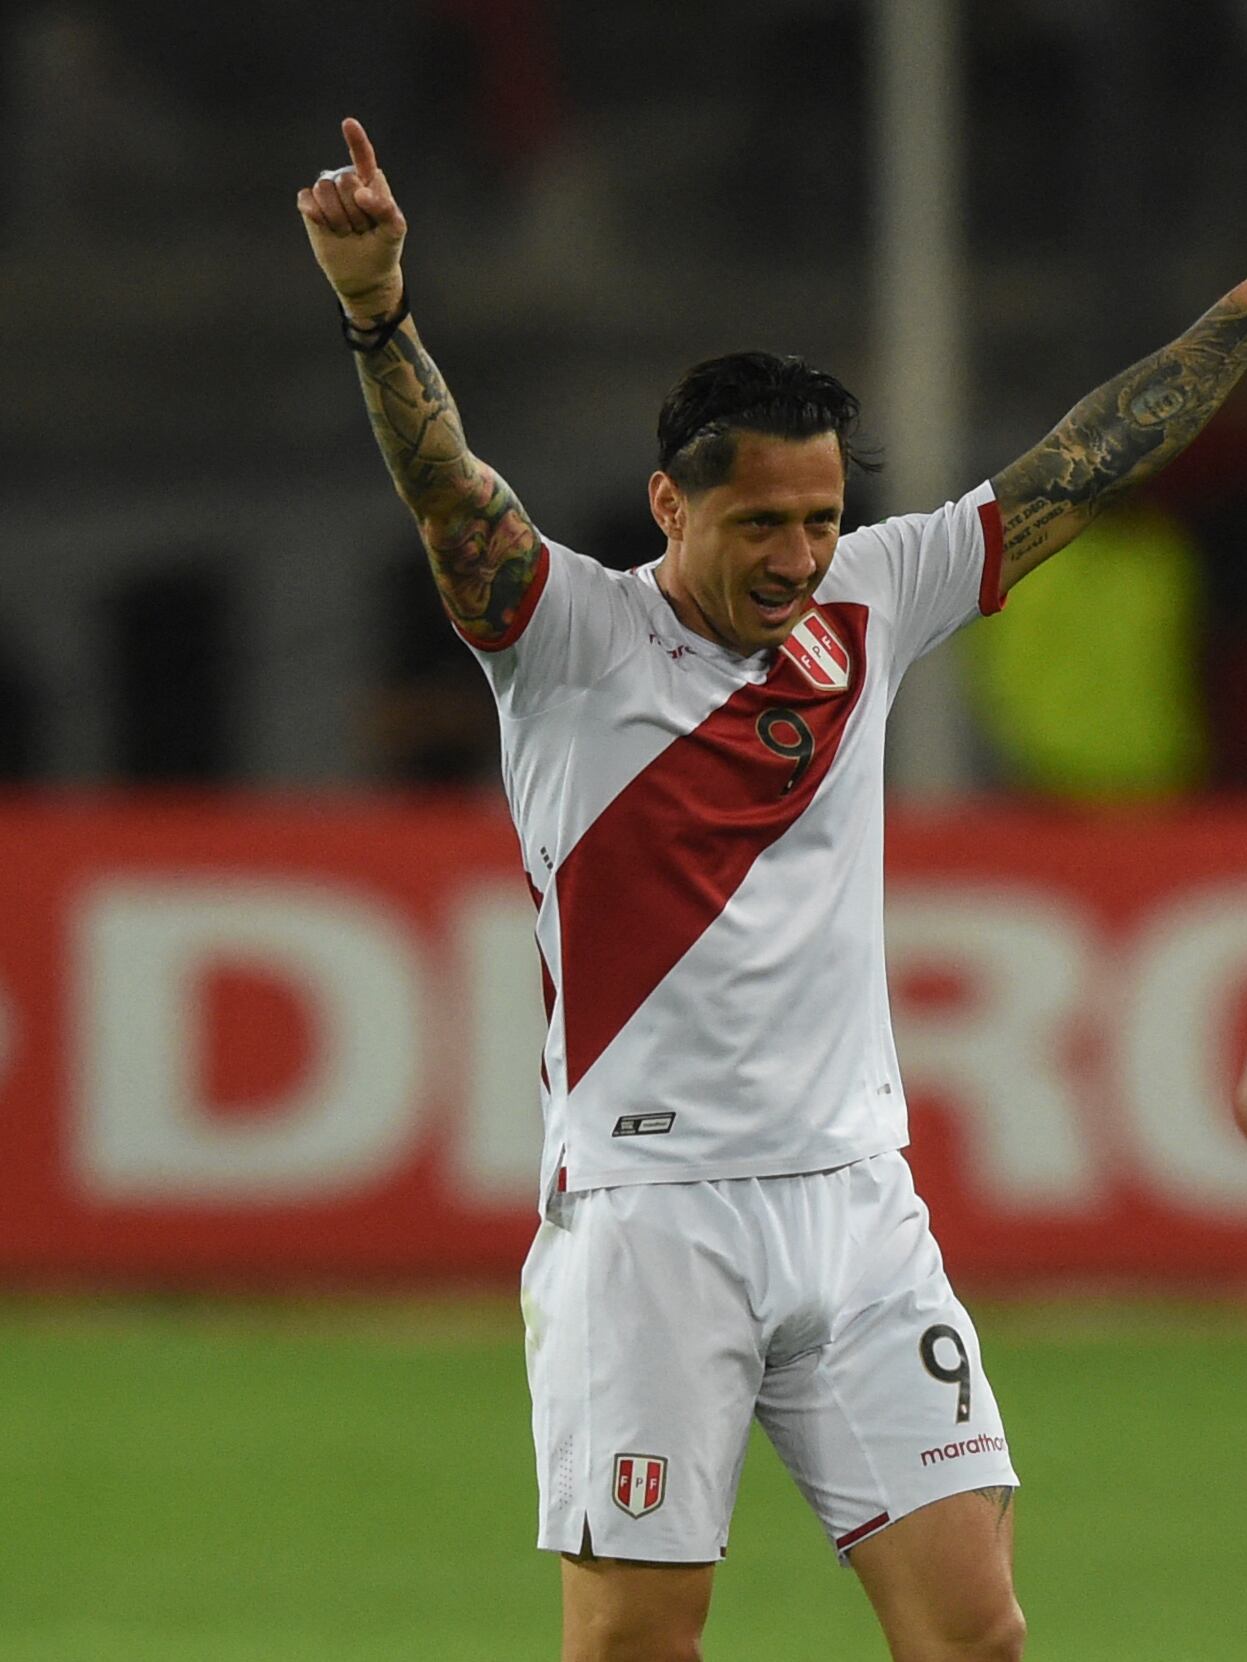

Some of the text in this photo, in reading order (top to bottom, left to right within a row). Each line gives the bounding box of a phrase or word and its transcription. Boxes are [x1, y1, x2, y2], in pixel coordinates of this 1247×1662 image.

[755, 707, 815, 797] 9
[919, 1323, 971, 1424] 9
[620, 1475, 657, 1490] FPF
